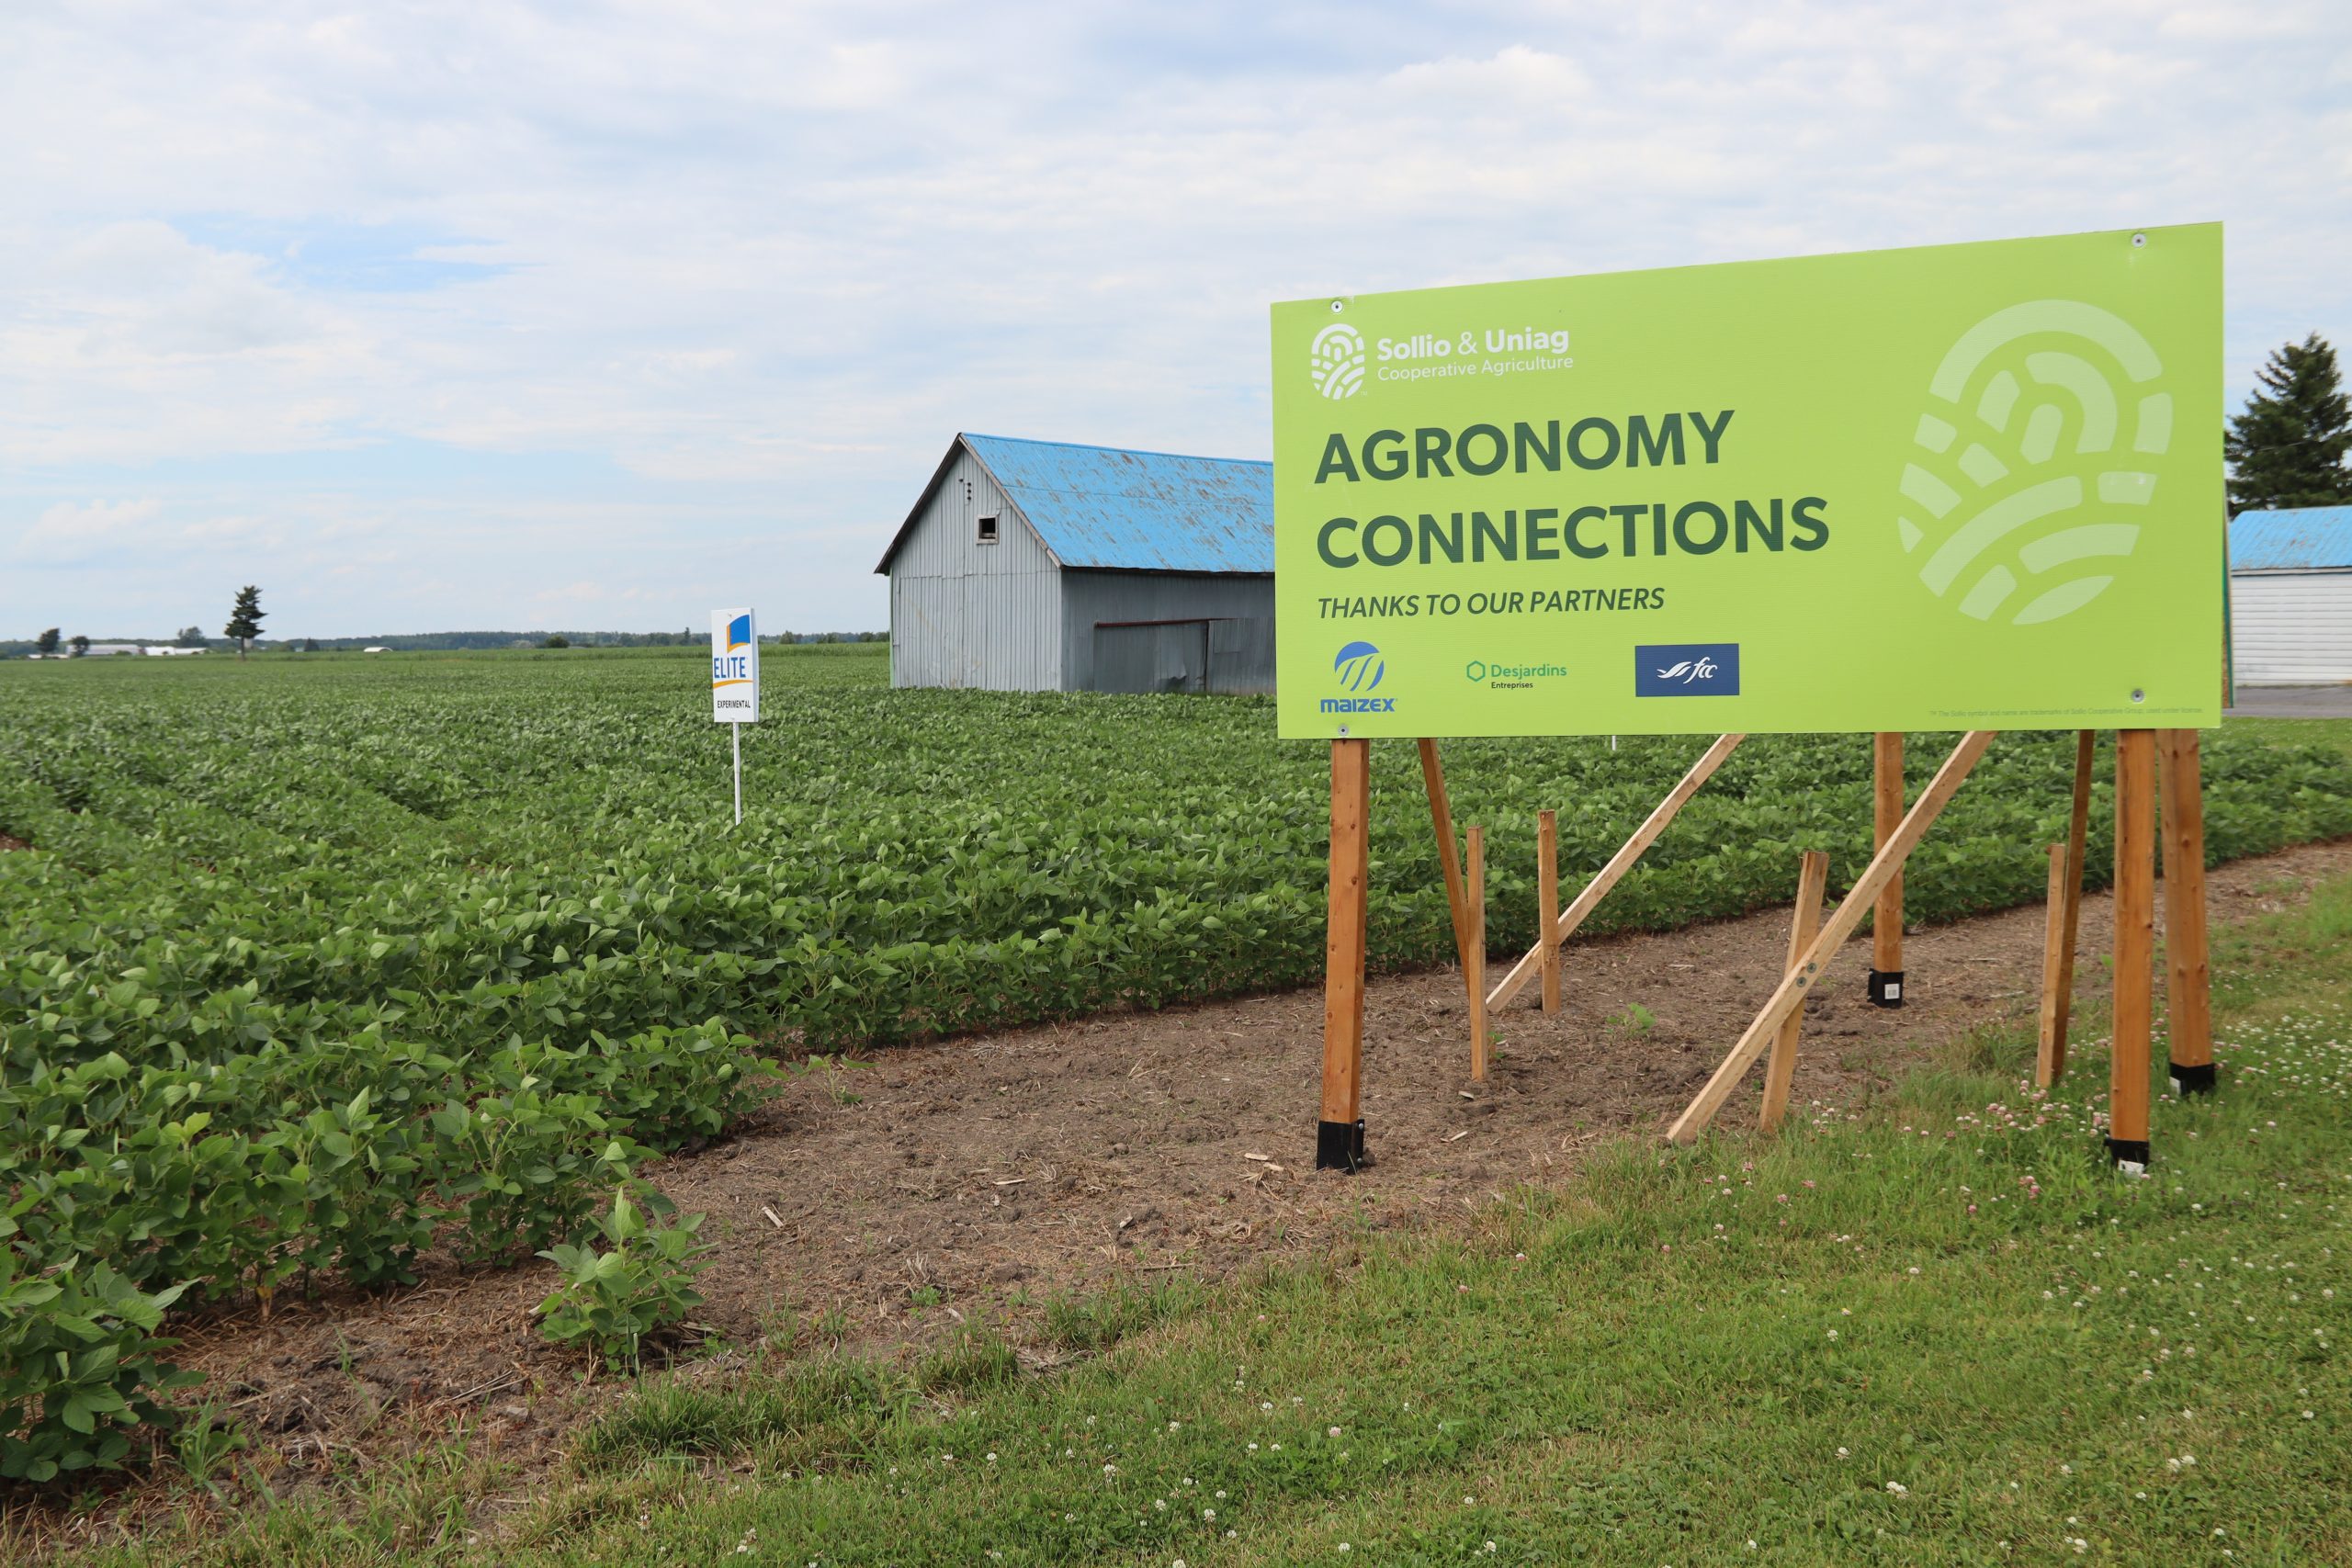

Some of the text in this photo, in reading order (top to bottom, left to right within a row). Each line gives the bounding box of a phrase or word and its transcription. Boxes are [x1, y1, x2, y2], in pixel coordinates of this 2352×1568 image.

[1377, 326, 1569, 361] Sollio & Uniag
[1377, 355, 1574, 382] Cooperative Agriculture
[1315, 410, 1735, 484] AGRONOMY
[1317, 497, 1829, 568] CONNECTIONS
[1318, 588, 1665, 618] THANKS TO OUR PARTNERS
[714, 656, 746, 678] ELITE
[1491, 664, 1567, 682] Desjardins
[718, 700, 751, 708] EXPERIMENTAL
